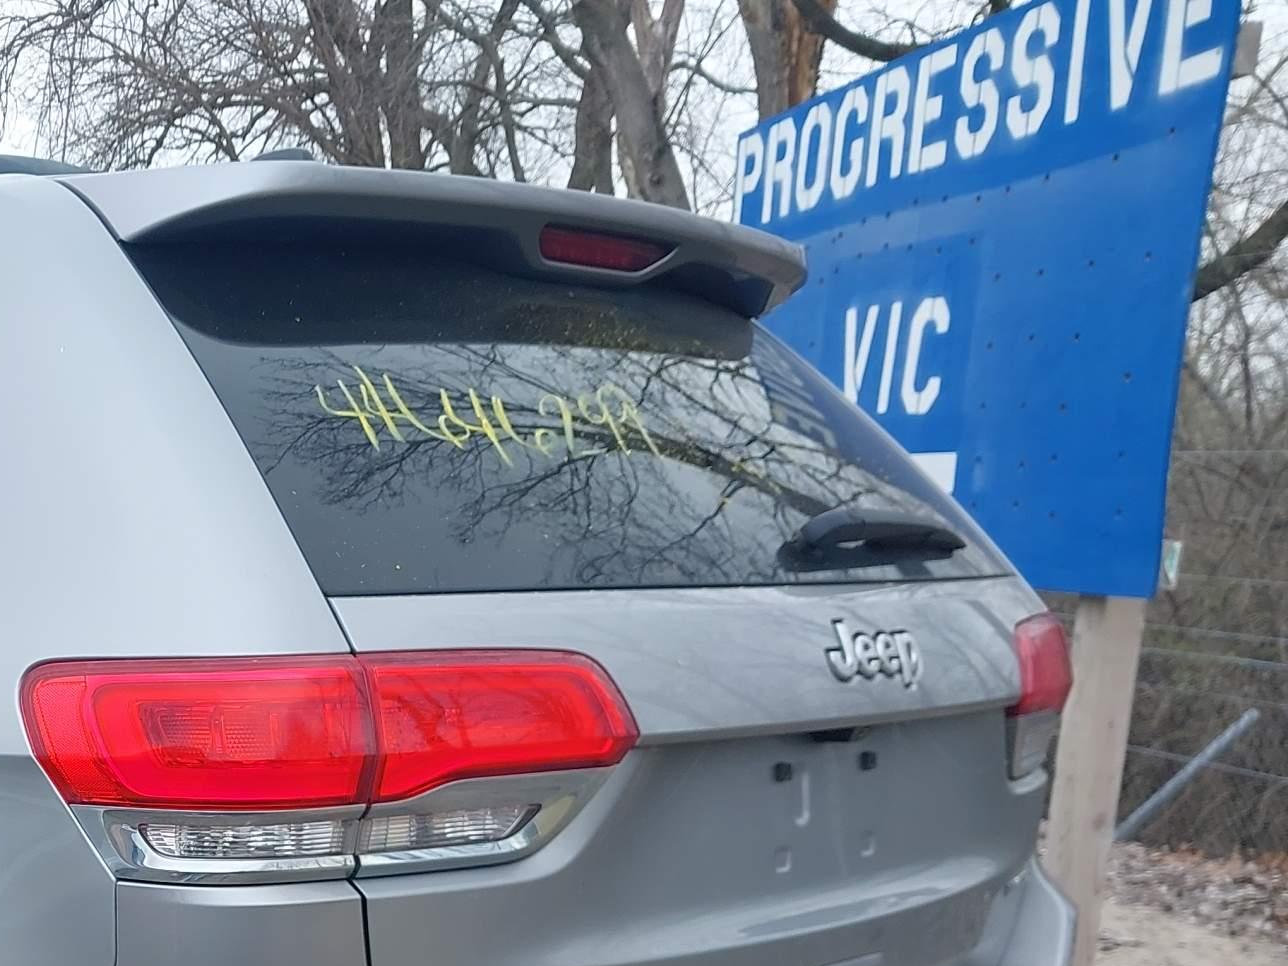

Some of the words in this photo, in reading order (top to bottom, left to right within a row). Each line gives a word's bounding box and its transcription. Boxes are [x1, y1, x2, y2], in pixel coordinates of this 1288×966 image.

[734, 0, 1226, 226] PROGRESSIVE
[842, 296, 951, 416] VIC
[824, 618, 923, 690] Jeep
